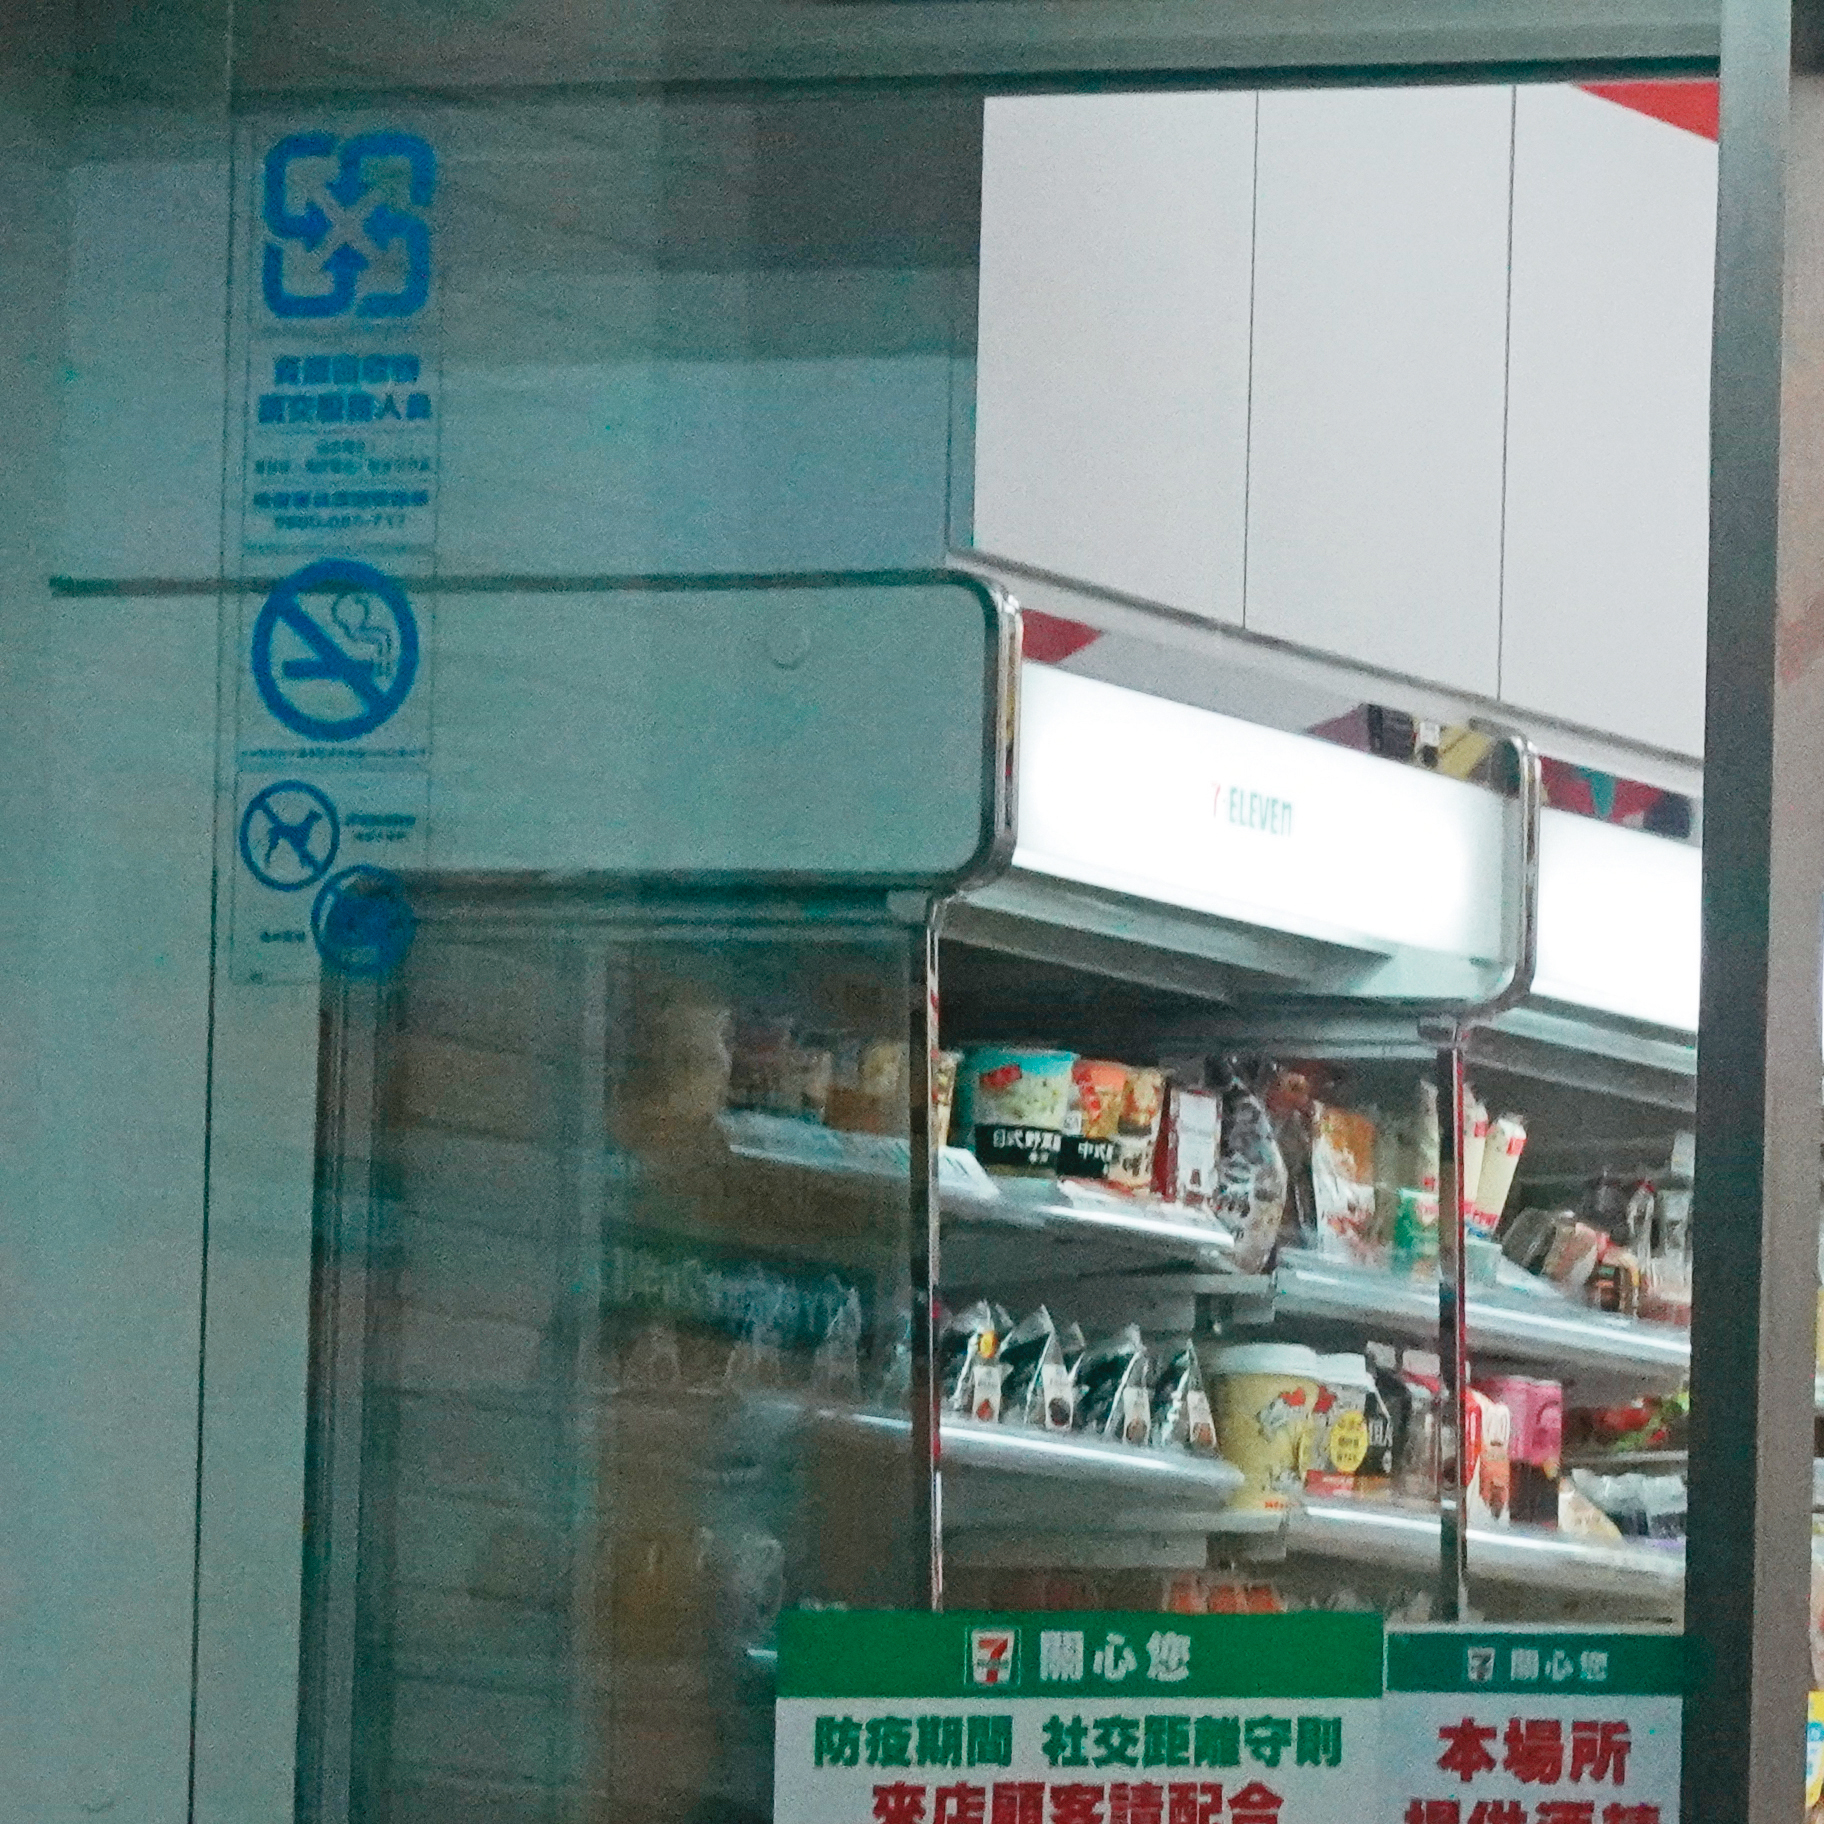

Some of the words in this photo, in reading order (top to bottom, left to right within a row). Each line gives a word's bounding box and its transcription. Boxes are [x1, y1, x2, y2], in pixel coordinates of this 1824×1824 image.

[1038, 1629, 1195, 1685] 關心您
[812, 1713, 1015, 1769] 防疫期間
[1041, 1713, 1345, 1769] 社交距離守則
[1437, 1717, 1634, 1786] 本場所
